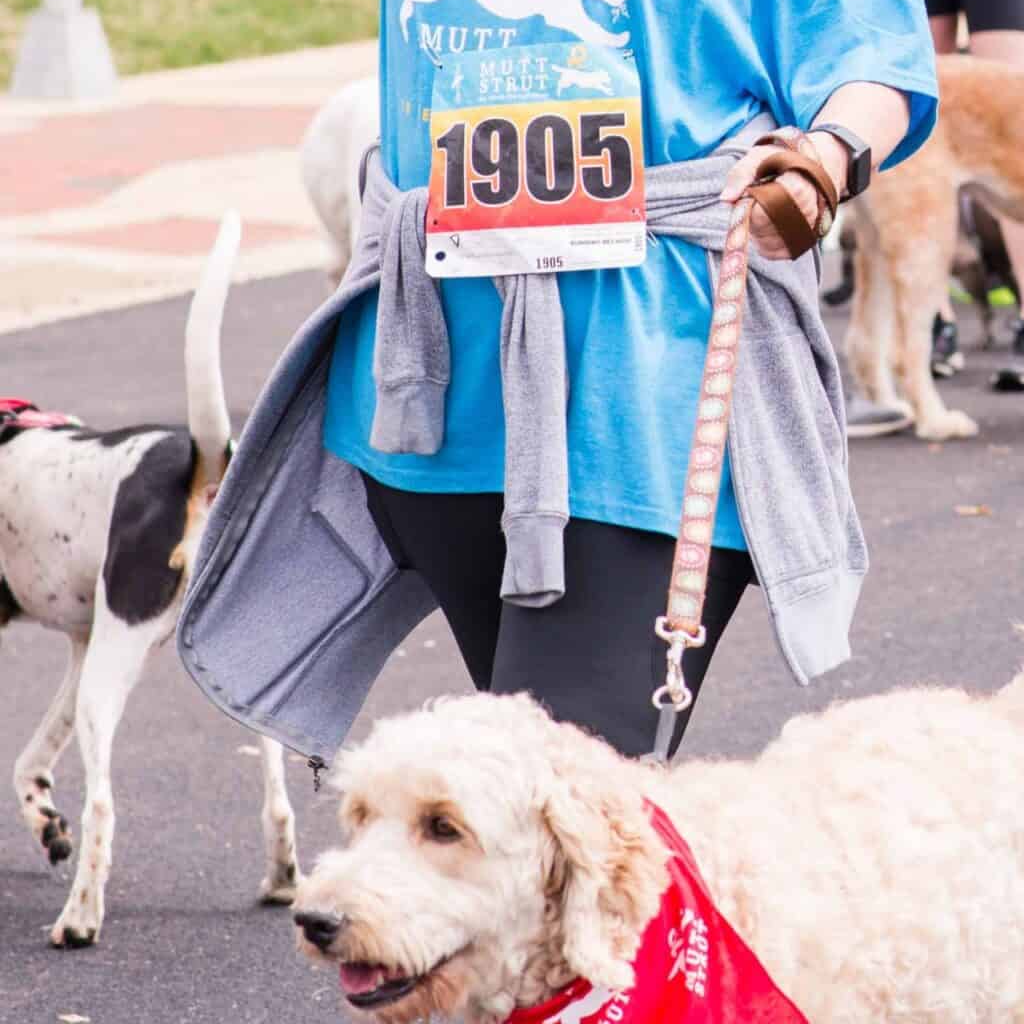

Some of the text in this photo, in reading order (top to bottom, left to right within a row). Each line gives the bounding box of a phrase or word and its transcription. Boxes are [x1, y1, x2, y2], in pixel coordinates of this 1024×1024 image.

[420, 23, 517, 52] MUTT
[480, 57, 548, 76] MUTT
[480, 75, 548, 95] STRUT
[435, 112, 634, 208] 1905
[536, 256, 564, 269] 1905
